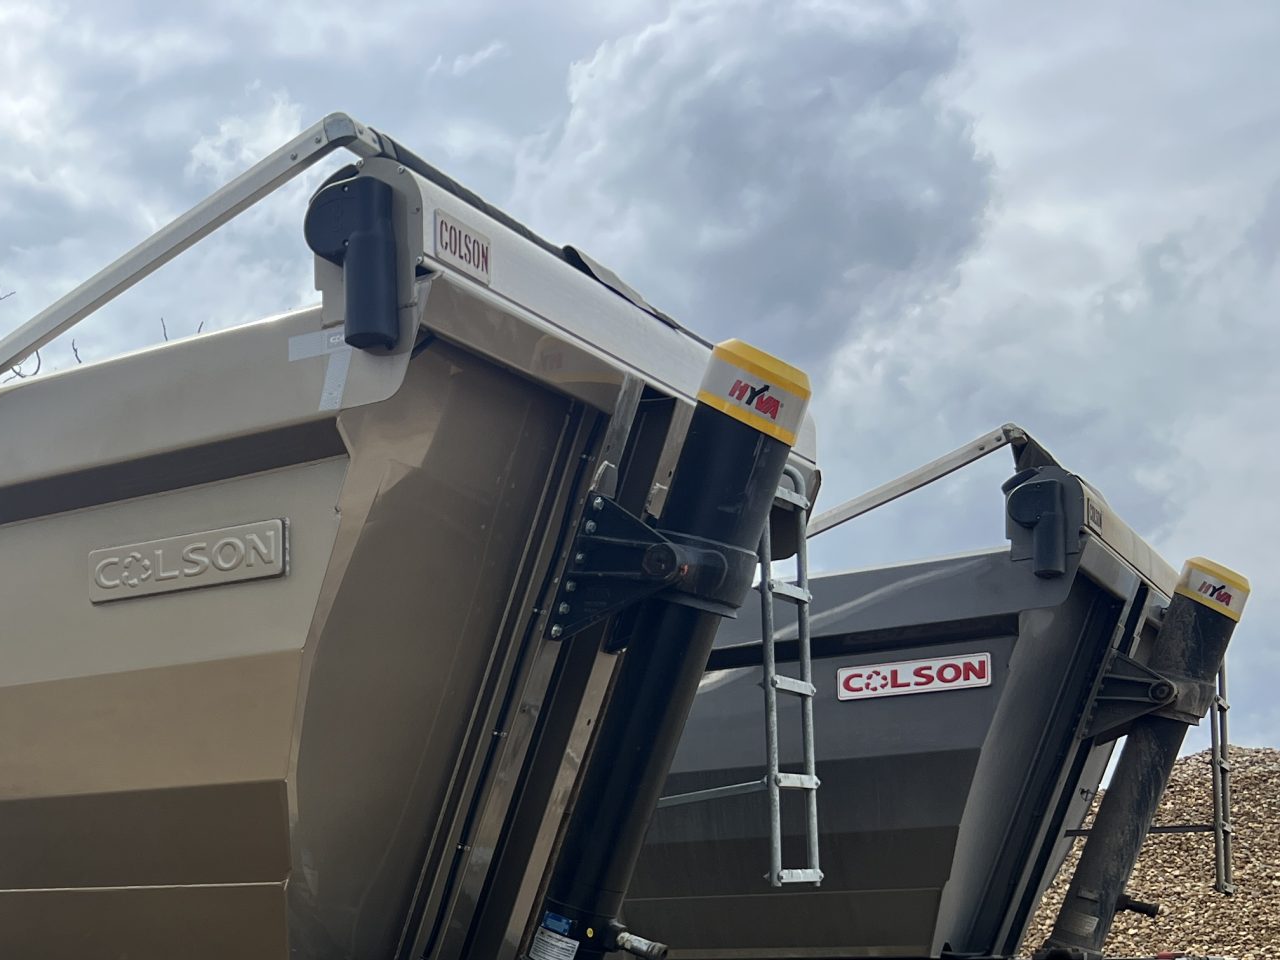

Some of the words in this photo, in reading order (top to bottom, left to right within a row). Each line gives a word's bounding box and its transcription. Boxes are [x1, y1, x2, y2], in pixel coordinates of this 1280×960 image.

[439, 219, 489, 275] COLSON
[728, 379, 780, 420] HYVA
[94, 530, 275, 590] COLSON
[1198, 580, 1233, 607] HYVA
[842, 659, 986, 693] COLSON
